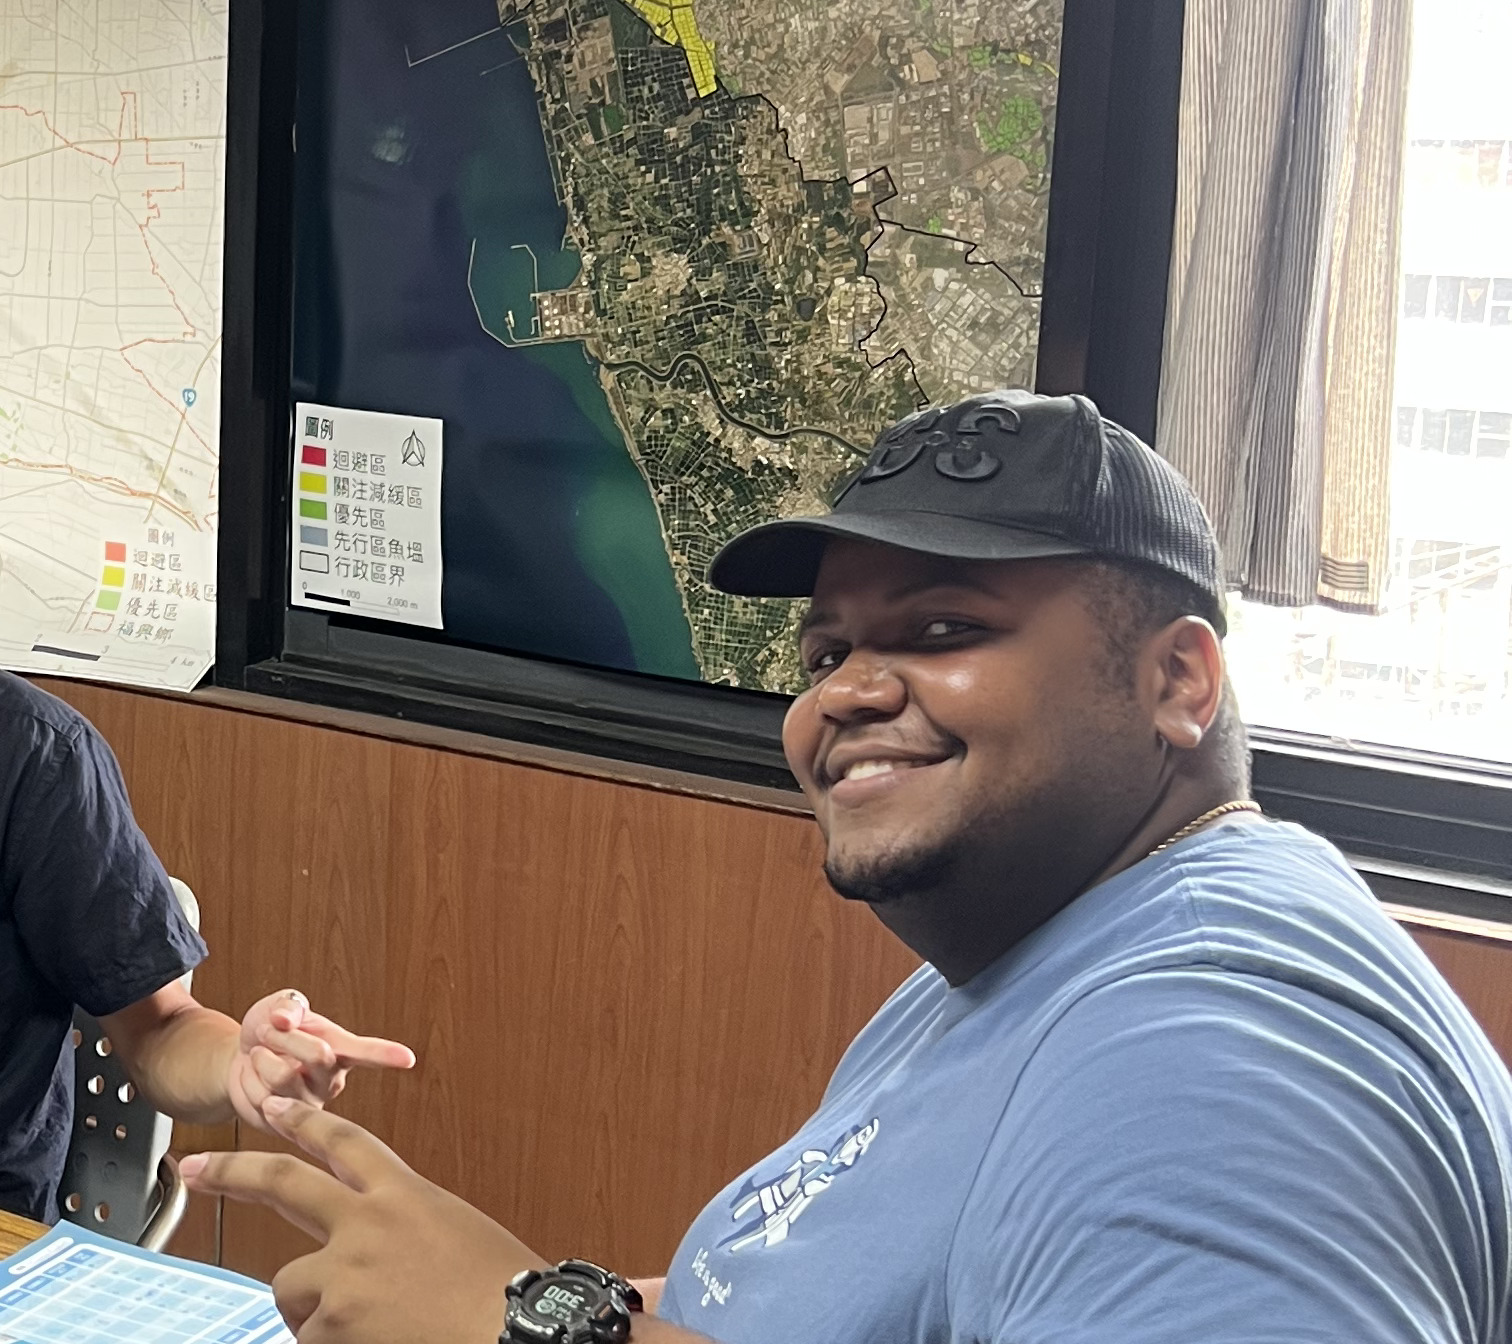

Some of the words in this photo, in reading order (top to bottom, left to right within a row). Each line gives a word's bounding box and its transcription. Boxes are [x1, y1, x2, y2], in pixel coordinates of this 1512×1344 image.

[184, 391, 195, 403] 19
[305, 416, 334, 440] 圖例
[333, 449, 386, 476] 迴避區
[333, 476, 423, 509] 關注減緩區
[334, 503, 386, 531] 優先區
[132, 548, 182, 572] 迴避區
[334, 556, 405, 587] 行政區界
[126, 596, 178, 621] 優先區
[117, 620, 174, 644] 福興鄉
[542, 1284, 585, 1310] 3:00
